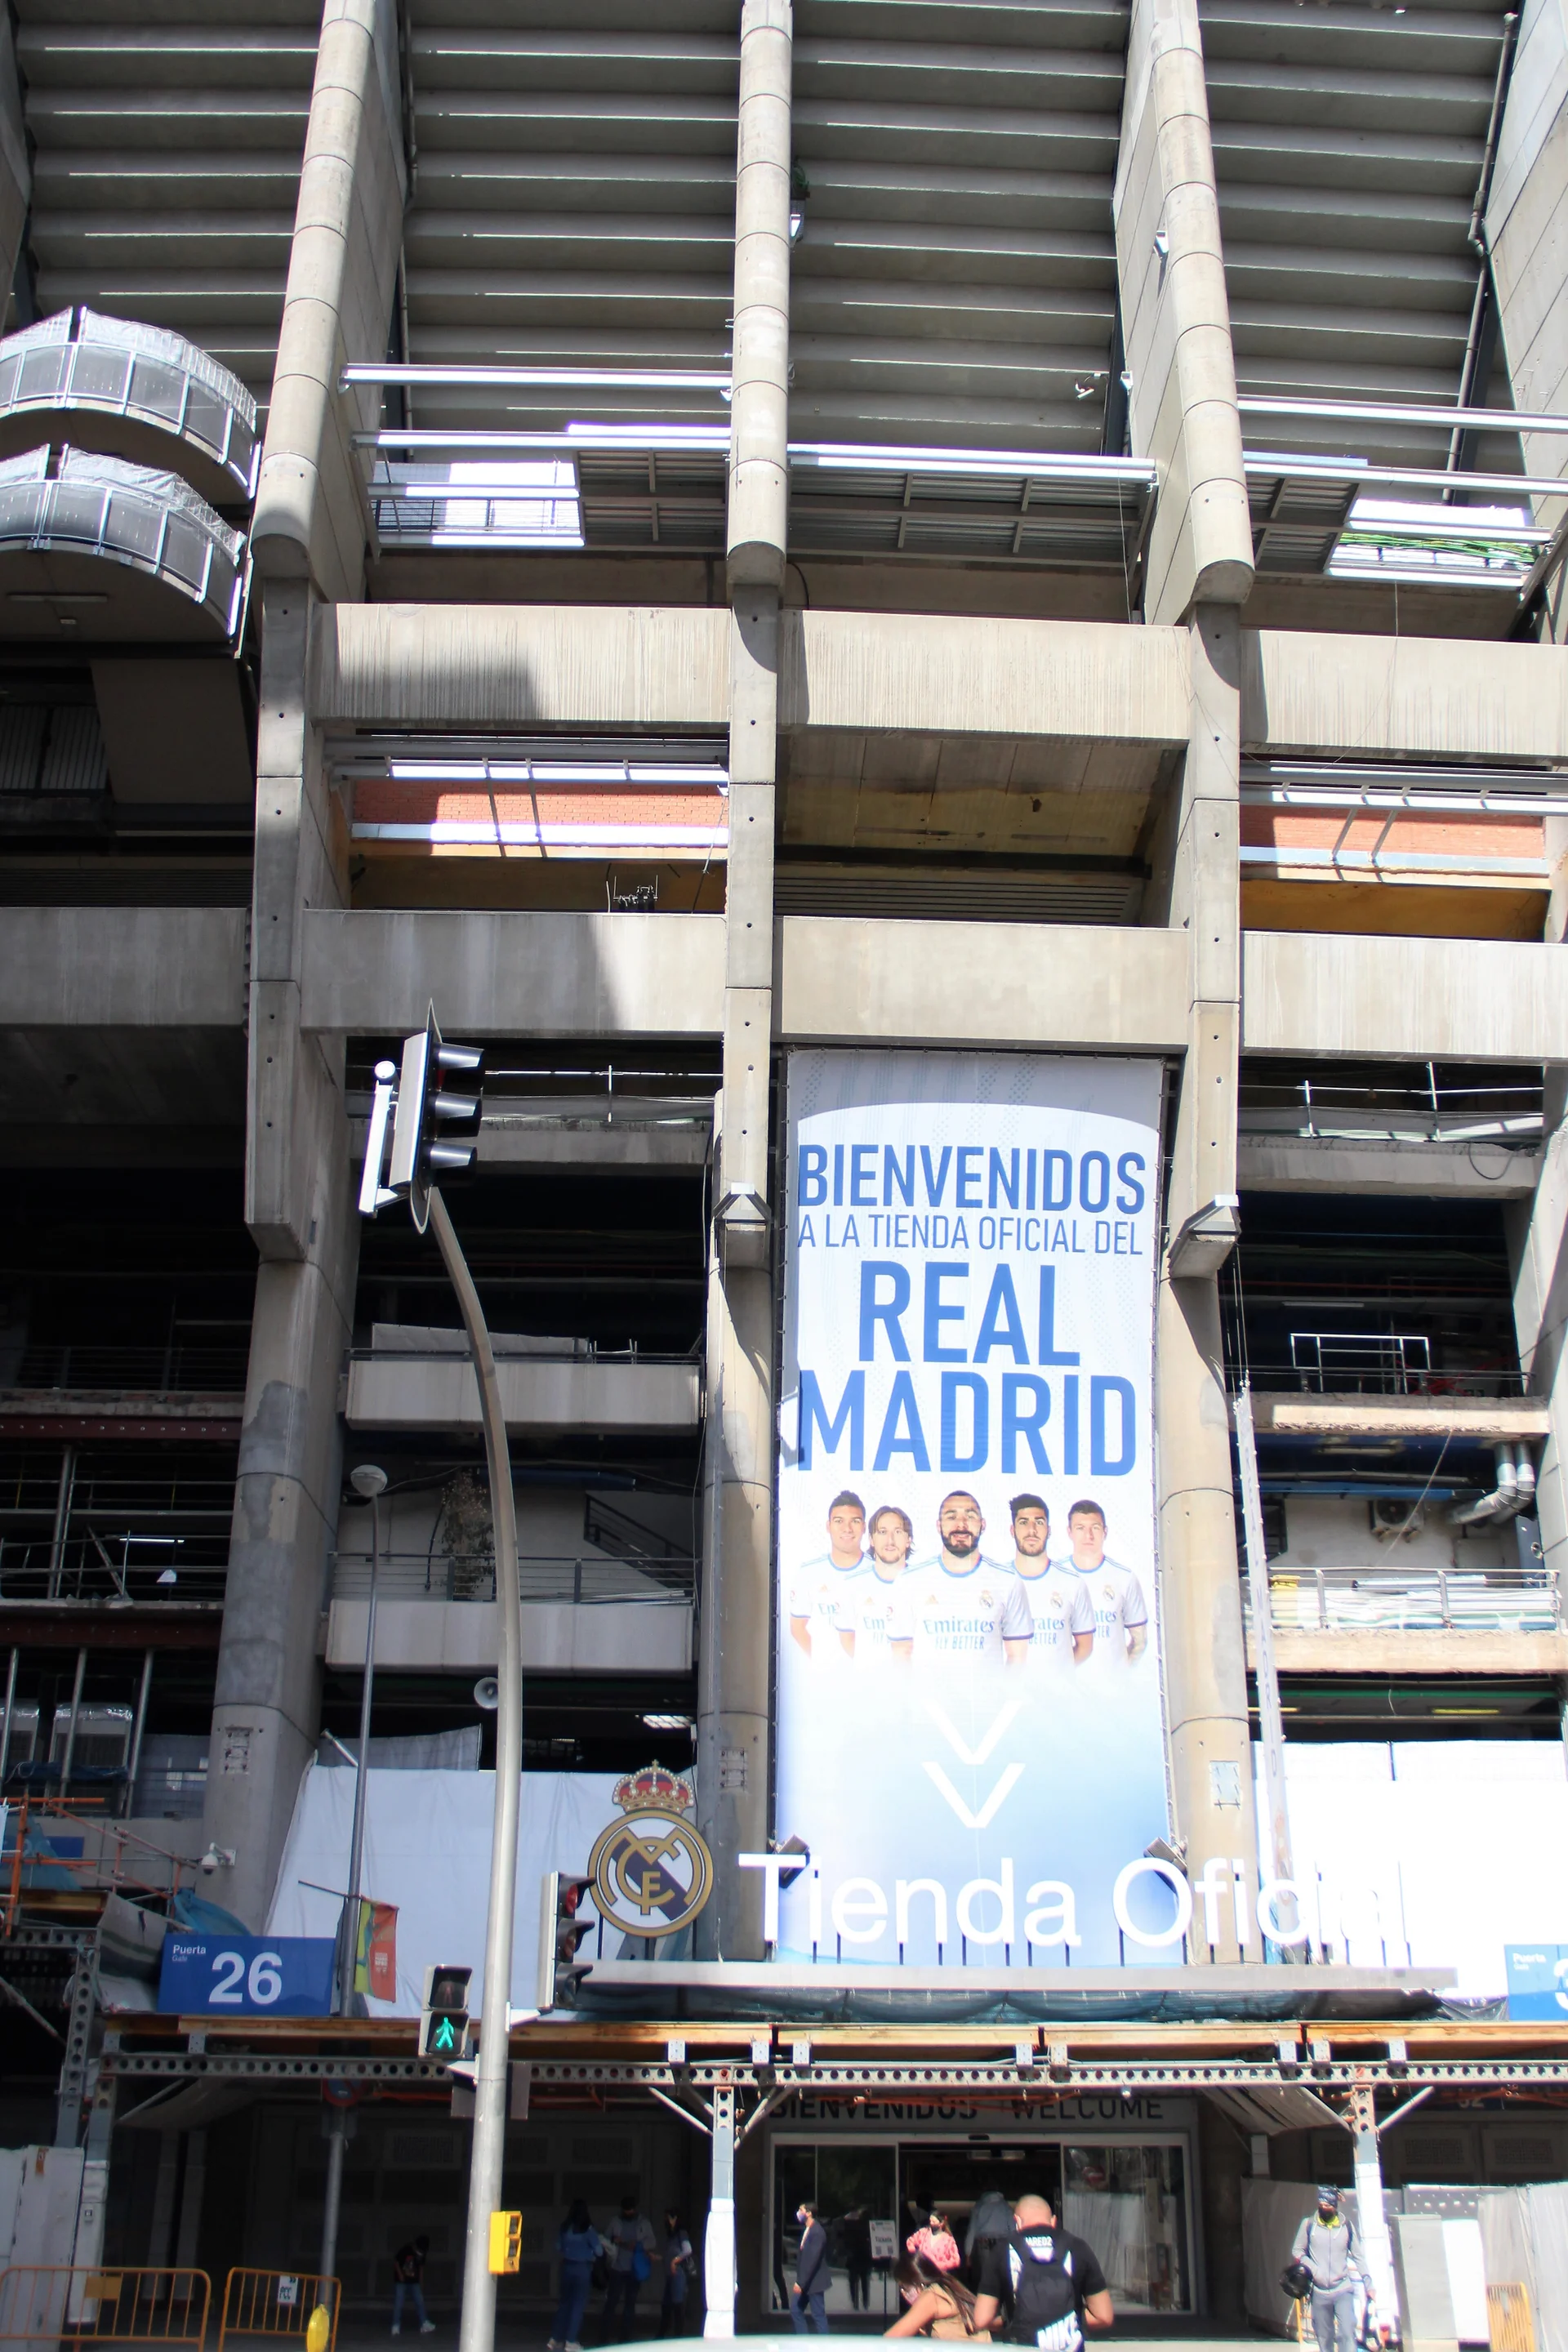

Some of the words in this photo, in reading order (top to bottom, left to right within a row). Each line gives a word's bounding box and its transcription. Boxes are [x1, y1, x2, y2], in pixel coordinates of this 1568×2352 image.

[798, 1144, 1146, 1214] BIENVENIDOS
[798, 1214, 816, 1247] A
[826, 1214, 860, 1248] LA
[868, 1214, 969, 1249] TIENDA
[979, 1216, 1085, 1254] OFICIAL
[1095, 1221, 1143, 1255] DEL
[858, 1260, 1080, 1366] REAL
[797, 1370, 1137, 1477] MADRID
[923, 1616, 995, 1633] Emirates
[952, 1635, 985, 1650] BETTER
[738, 1853, 1082, 1947] Tienda
[172, 1944, 207, 1954] Puerta
[208, 1951, 283, 2005] 26
